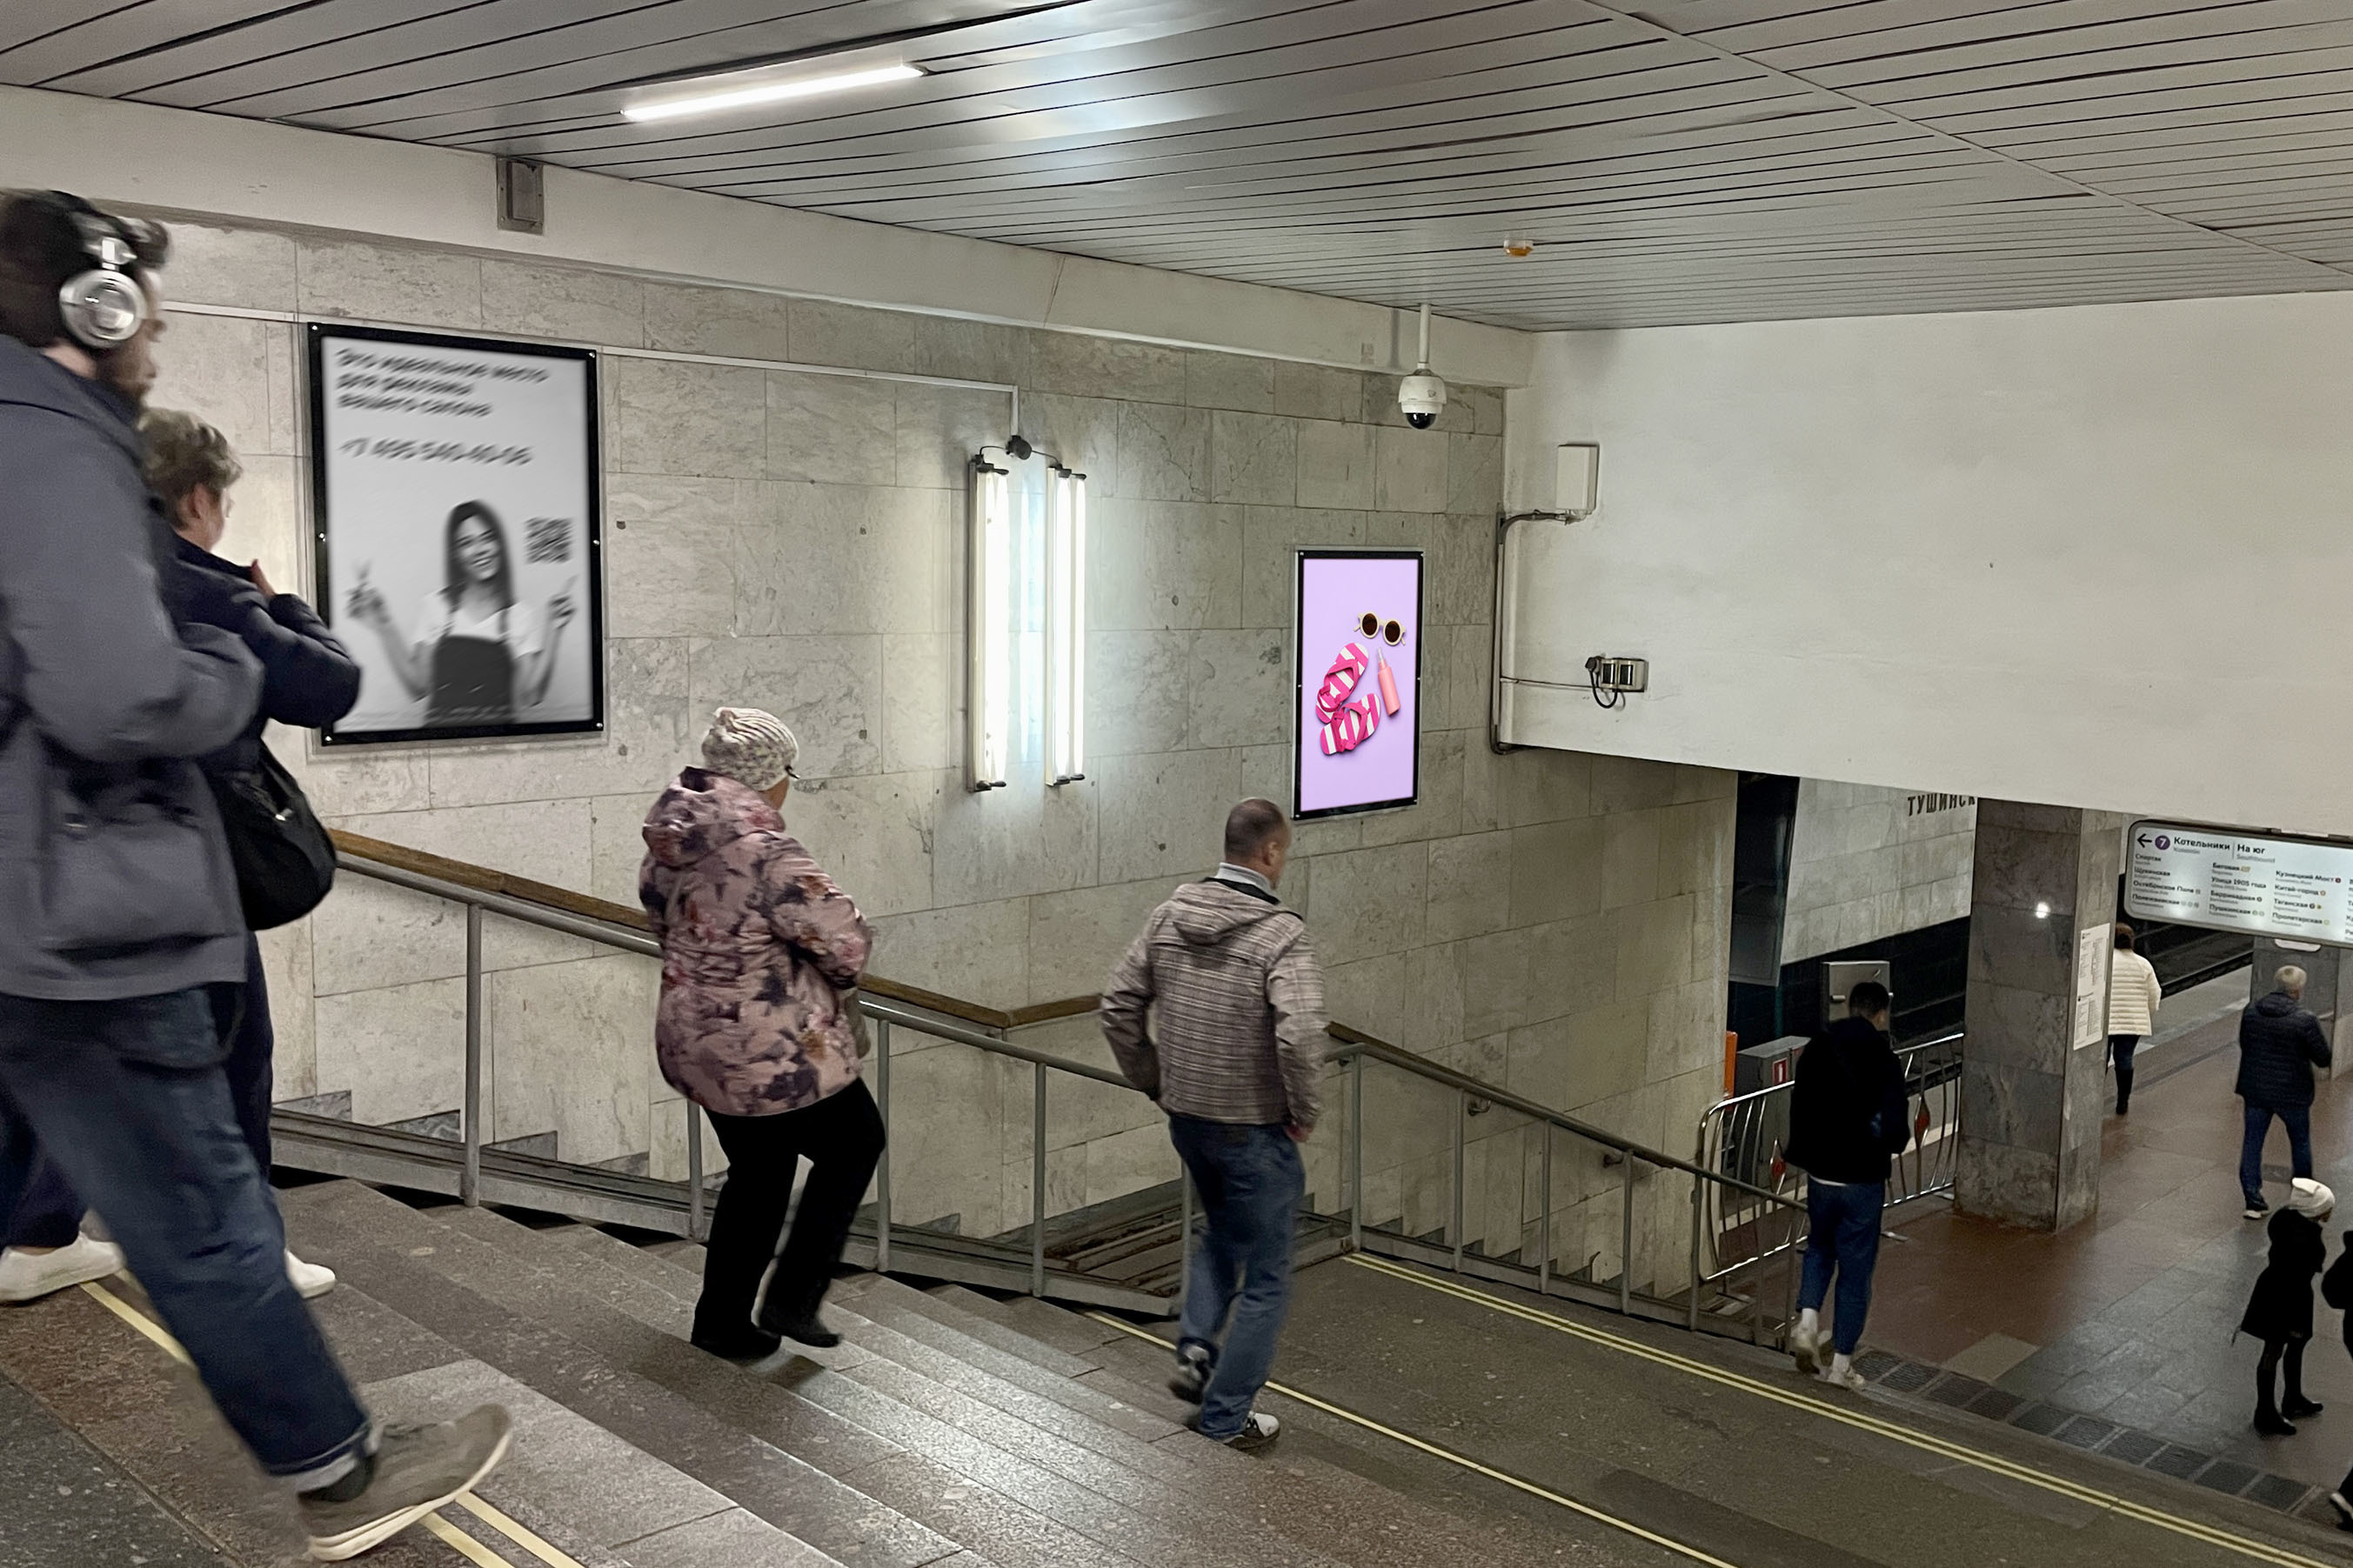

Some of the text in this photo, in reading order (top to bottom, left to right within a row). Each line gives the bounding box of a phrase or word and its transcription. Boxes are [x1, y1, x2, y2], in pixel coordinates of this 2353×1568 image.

[2159, 837, 2167, 848] 7
[2174, 837, 2230, 851] Котельники
[2237, 844, 2250, 853] На
